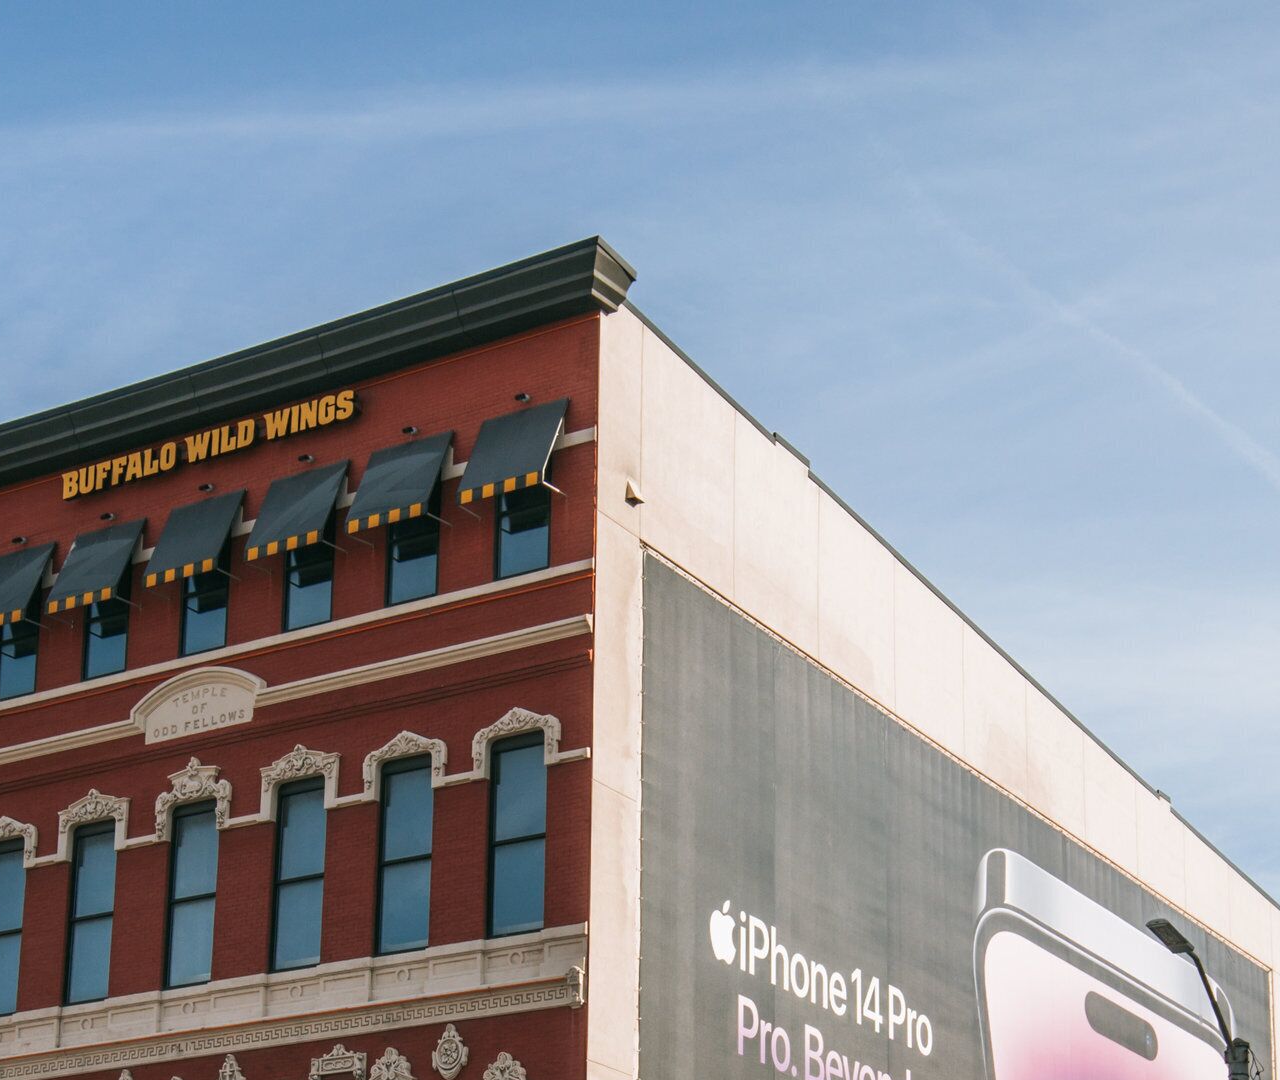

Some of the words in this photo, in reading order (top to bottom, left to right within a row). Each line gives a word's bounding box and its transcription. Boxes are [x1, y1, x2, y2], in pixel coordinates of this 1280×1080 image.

[62, 441, 176, 500] BUFFALO
[185, 418, 255, 463] WILD
[264, 389, 354, 440] WINGS
[154, 725, 177, 738] ODD
[184, 709, 245, 731] FELLOWS
[173, 687, 228, 707] TEMPLE
[192, 702, 207, 714] OF
[739, 910, 847, 1016] iPhone
[851, 968, 883, 1033] 14
[888, 984, 932, 1056] Pro
[738, 994, 797, 1077] Pro.
